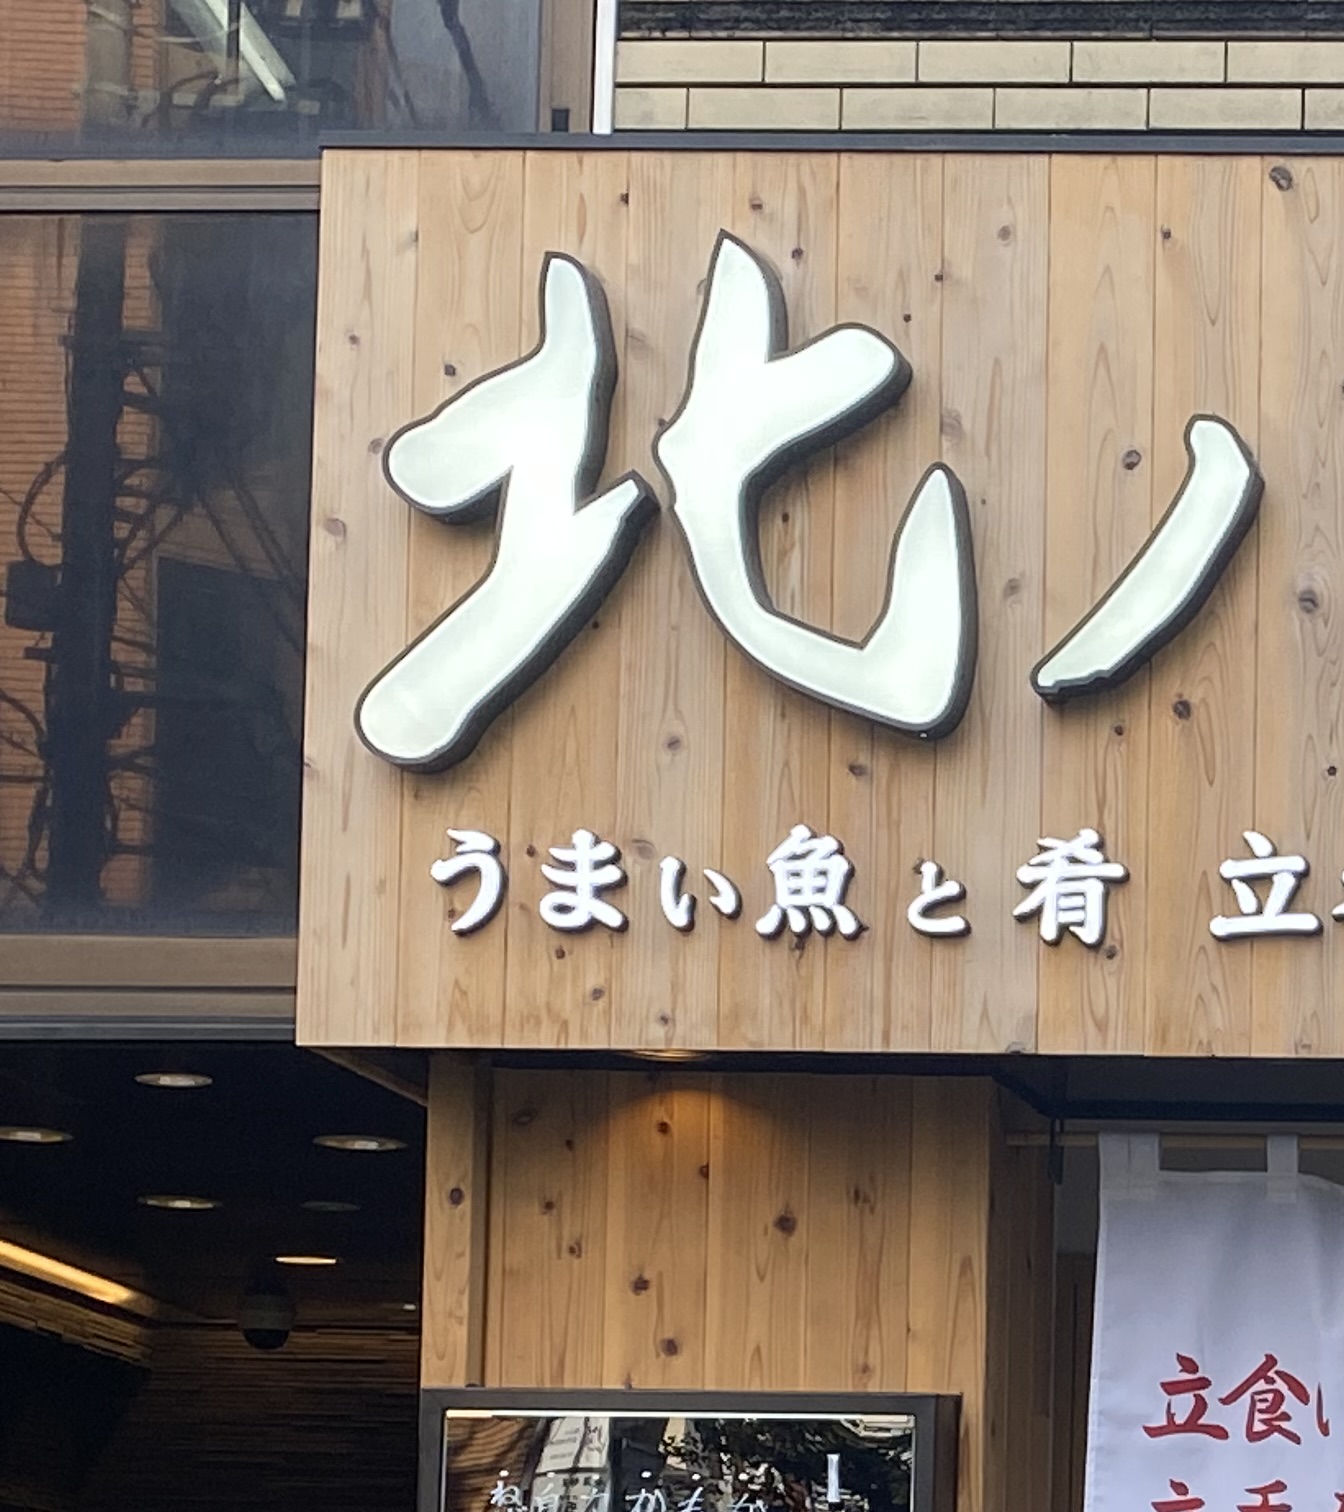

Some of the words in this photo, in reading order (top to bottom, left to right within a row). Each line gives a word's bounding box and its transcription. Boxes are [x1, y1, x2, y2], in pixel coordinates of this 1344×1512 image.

[430, 825, 1128, 946] うまい魚と肴
